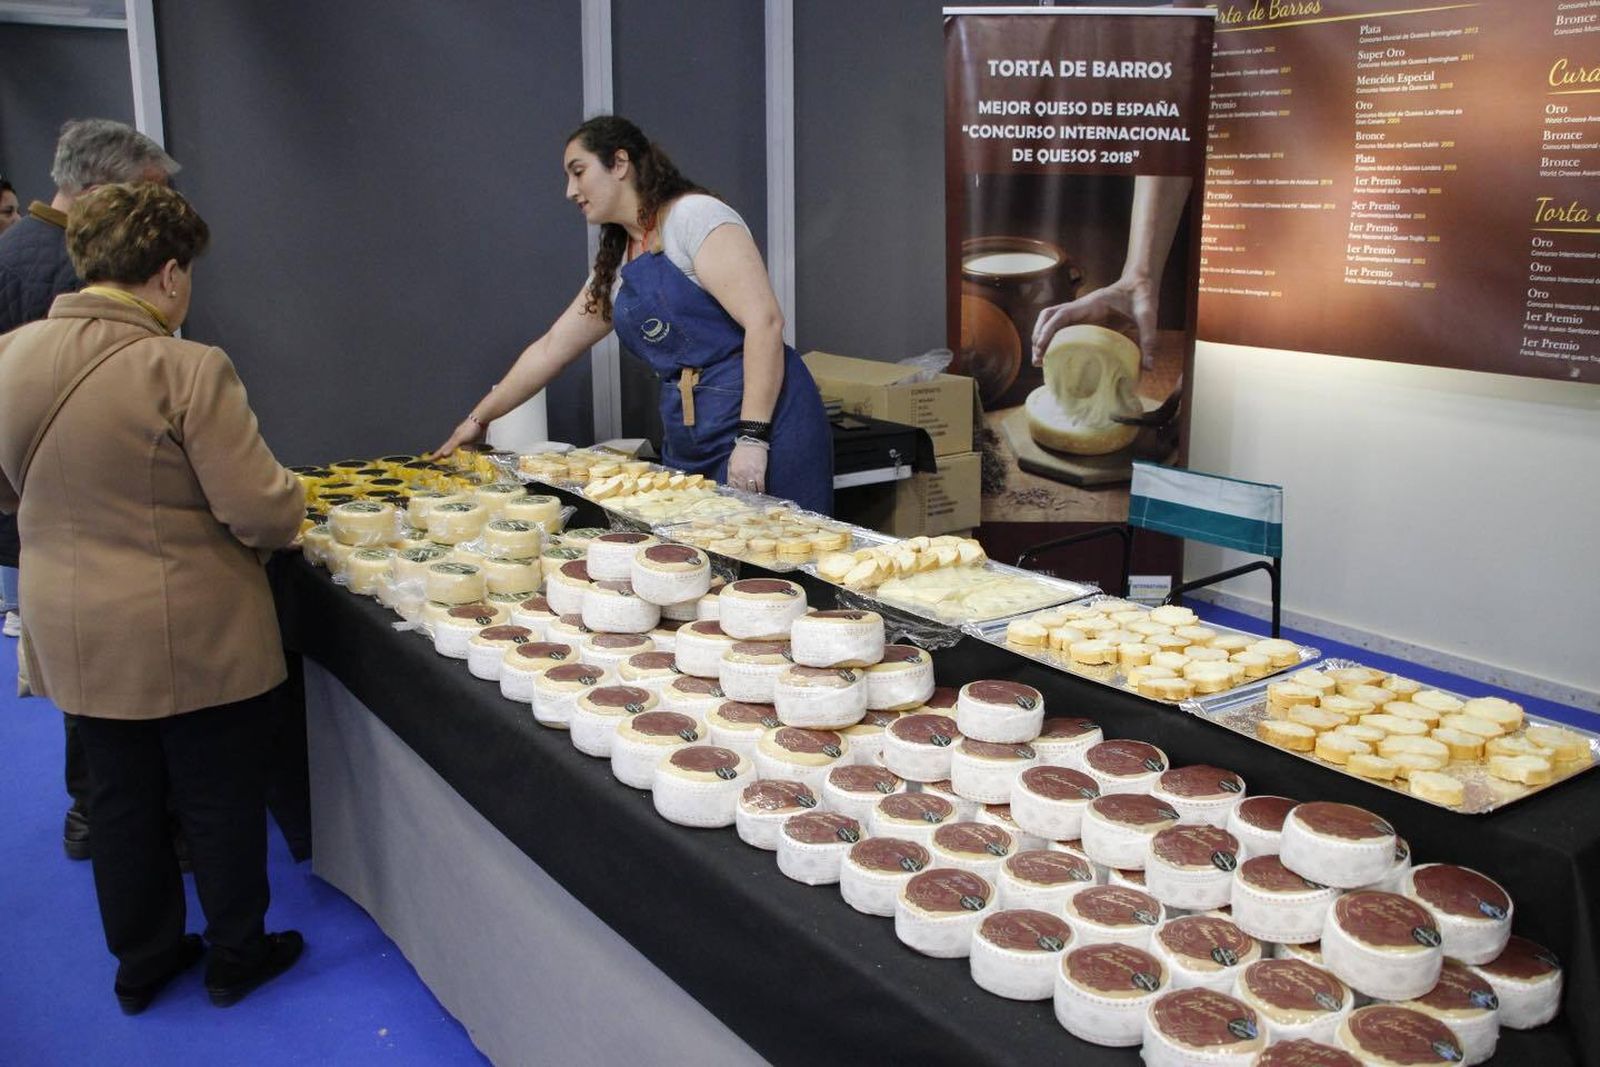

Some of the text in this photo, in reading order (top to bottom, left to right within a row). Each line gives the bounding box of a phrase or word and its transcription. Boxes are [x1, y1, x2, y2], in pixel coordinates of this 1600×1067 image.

[1247, 1, 1265, 21] de
[1269, 0, 1322, 20] Barros
[1556, 14, 1598, 26] Bronce
[1360, 24, 1381, 34] Plata
[1358, 48, 1406, 62] Super Oro
[987, 60, 1173, 79] TORTA DE BARROS
[1356, 71, 1436, 86] Mención Especial
[978, 100, 1179, 117] MEJOR QUESO DE ESPAÑA
[1211, 100, 1237, 110] Premio
[1355, 101, 1373, 110] Oro
[1545, 104, 1568, 114] Oro
[962, 125, 1056, 140] "CONCURSO
[1060, 125, 1191, 142] INTERNACIONAL
[1355, 131, 1386, 141] Bronce
[1543, 130, 1584, 140] Bronce
[1012, 149, 1139, 164] DE QUESOS 2018"
[1355, 154, 1376, 164] Plata
[1540, 156, 1581, 168] Bronce
[1208, 167, 1234, 176] Premio
[1355, 176, 1401, 186] 1er Premio
[1207, 190, 1233, 200] Premio
[1368, 200, 1400, 211] Premio
[1534, 196, 1592, 224] Torta
[1350, 222, 1398, 233] 1er Premio
[1532, 236, 1554, 248] Oro
[1346, 244, 1396, 256] 1er Premio
[1344, 266, 1394, 278] 1er Premio
[1530, 262, 1552, 273] Oro
[1528, 288, 1550, 299] Oro
[1526, 310, 1583, 324] 1er Premio
[1522, 337, 1580, 351] 1er Premio
